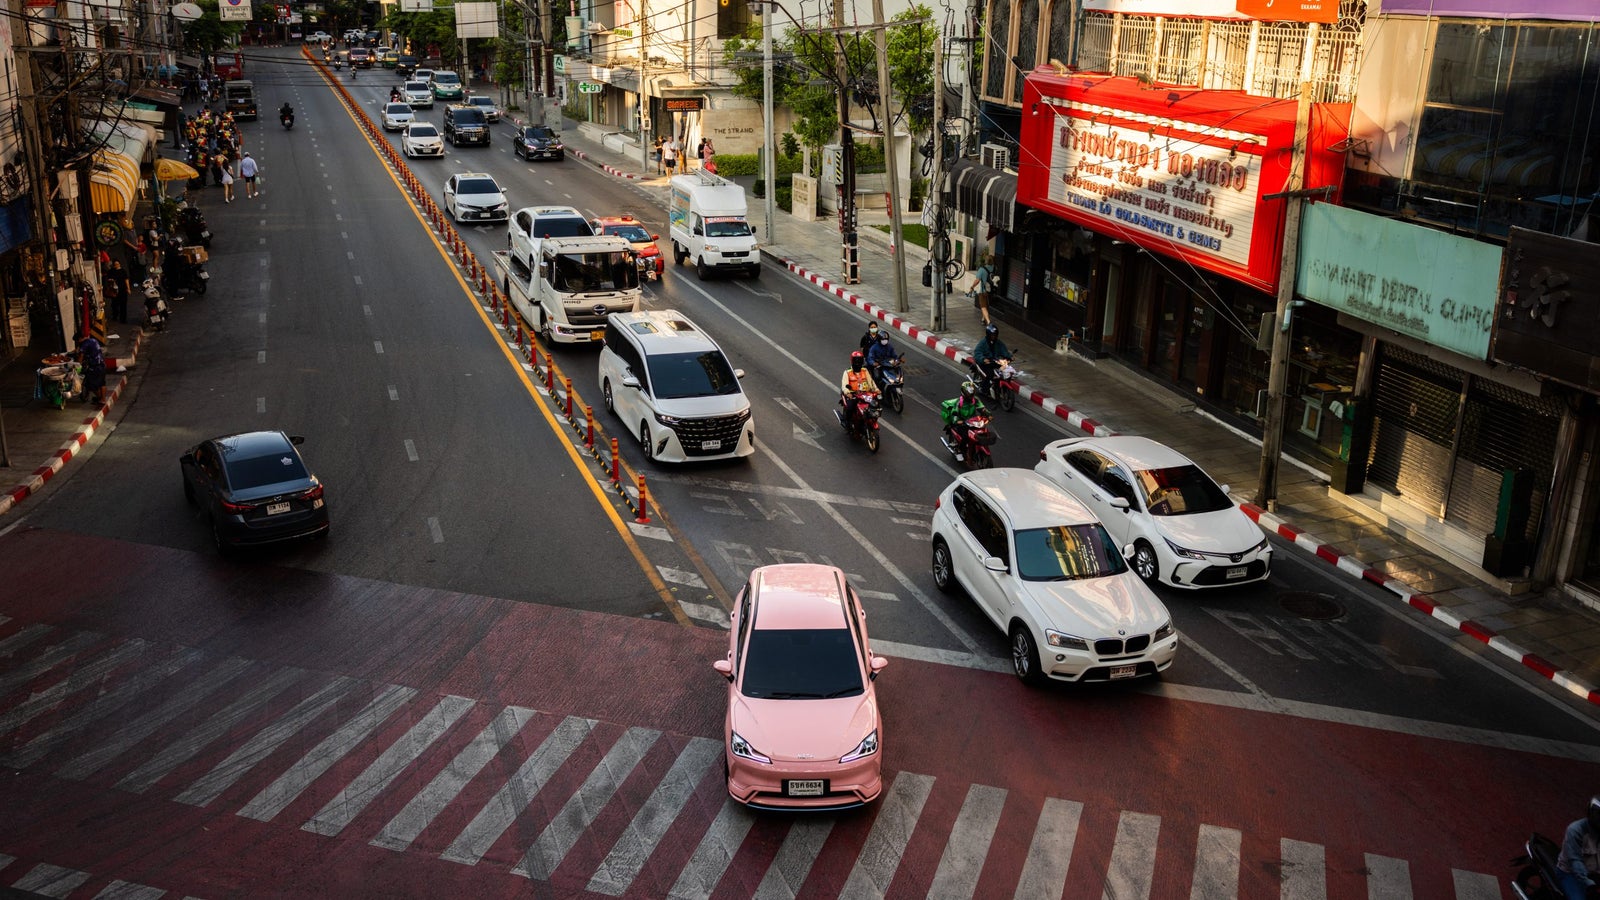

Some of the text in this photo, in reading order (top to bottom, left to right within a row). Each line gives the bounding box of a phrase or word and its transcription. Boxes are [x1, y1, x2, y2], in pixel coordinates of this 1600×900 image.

[590, 84, 601, 92] ยา
[1148, 179, 1167, 194] และ
[1067, 191, 1222, 251] THONG LO GOLDSMITH & GEMS
[1380, 278, 1434, 315] DENTAL
[1440, 297, 1493, 333] CLINIC
